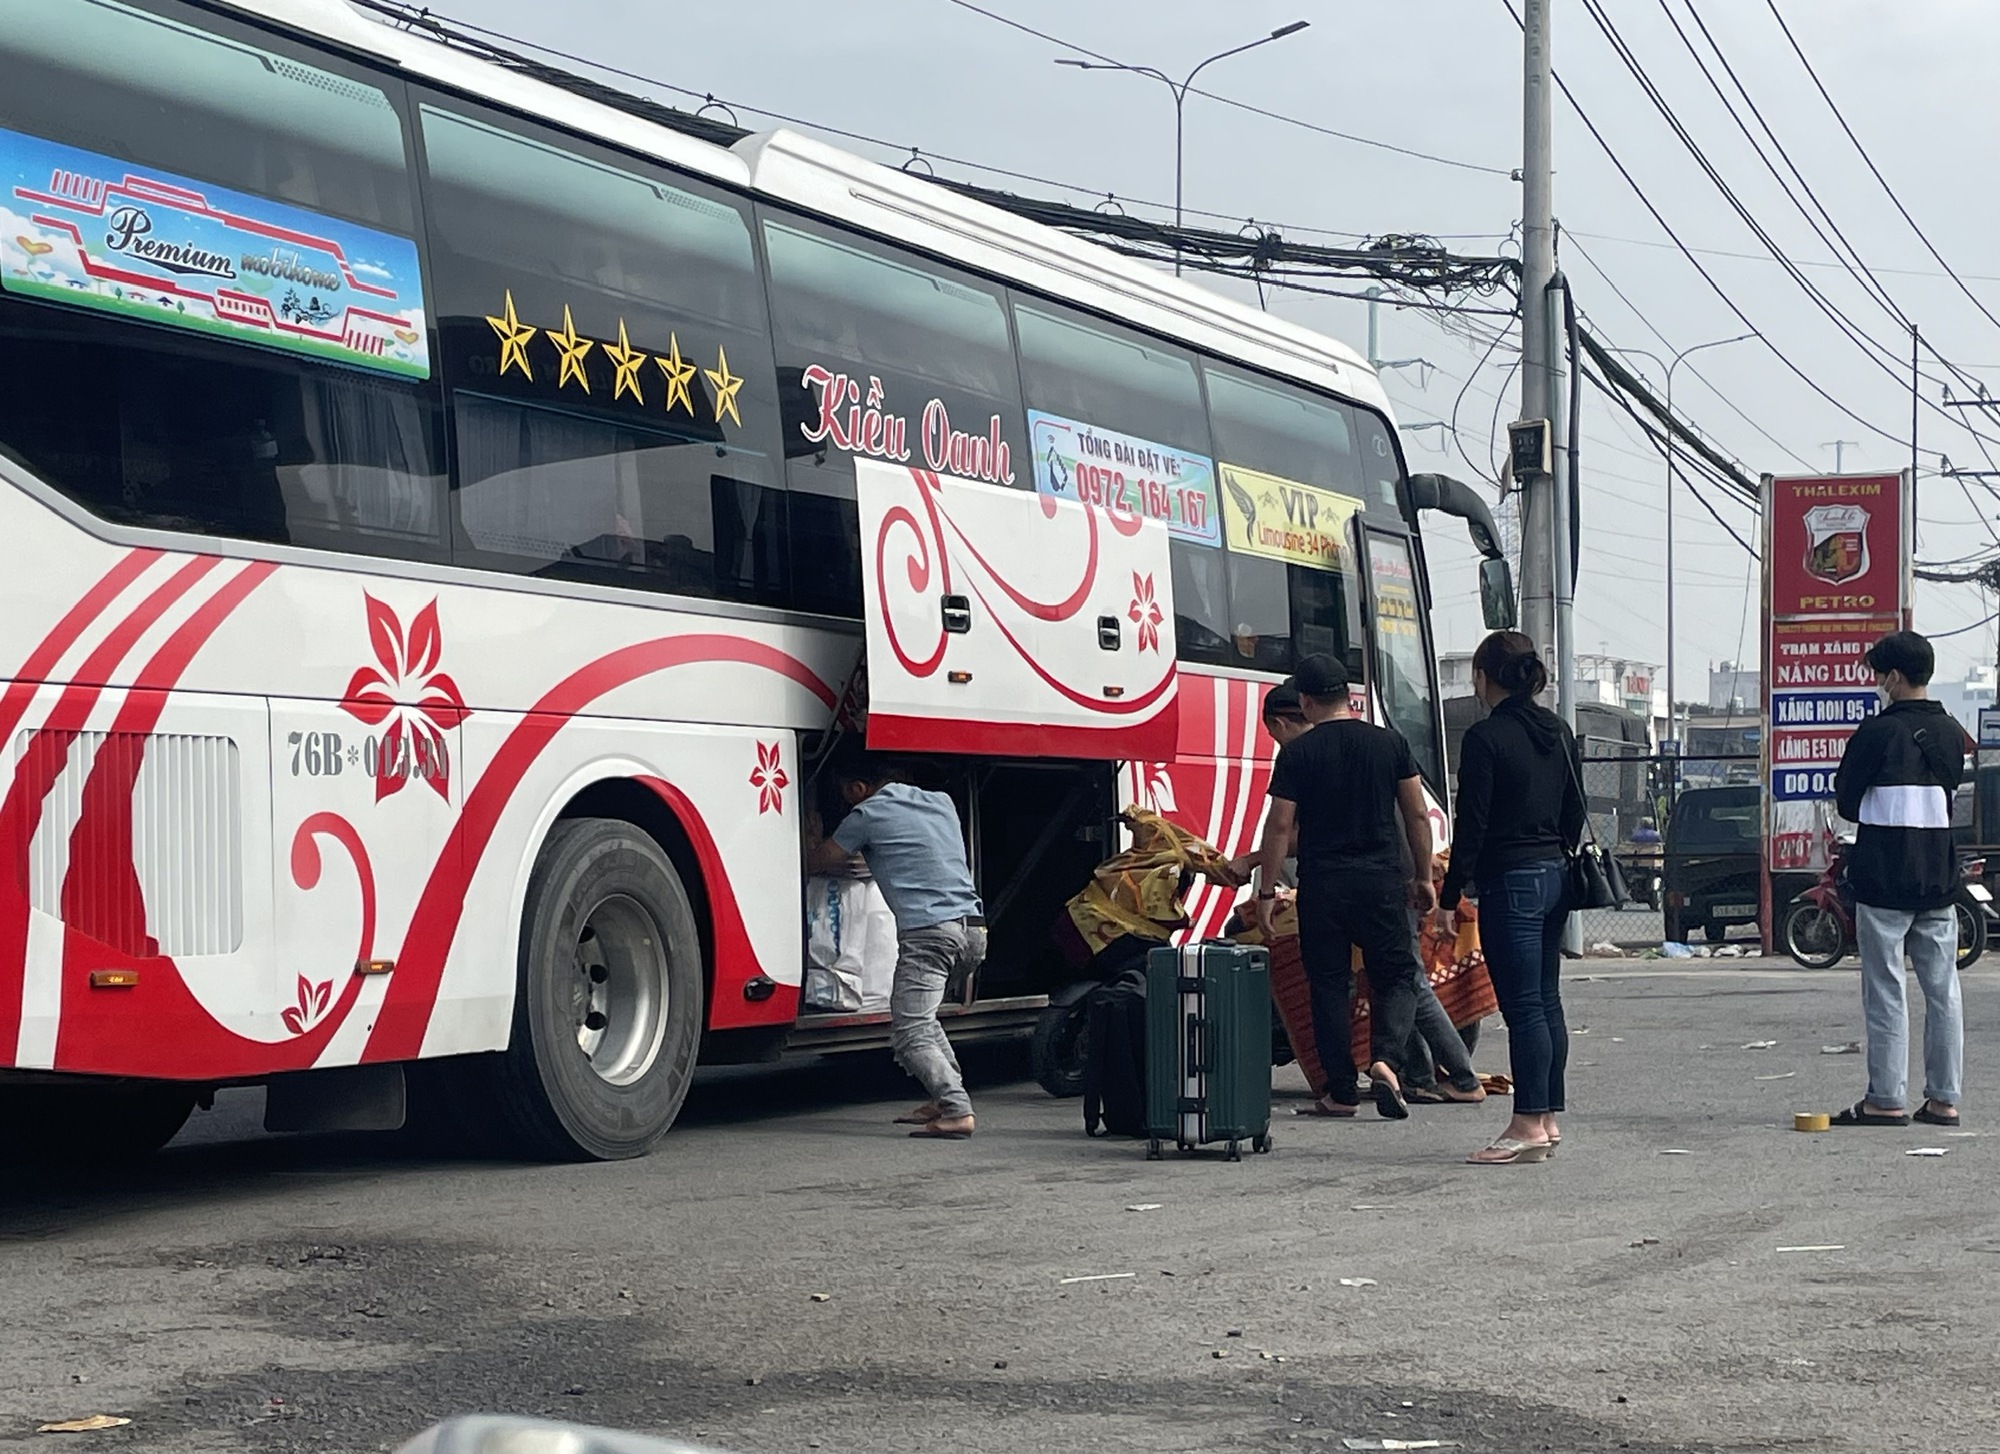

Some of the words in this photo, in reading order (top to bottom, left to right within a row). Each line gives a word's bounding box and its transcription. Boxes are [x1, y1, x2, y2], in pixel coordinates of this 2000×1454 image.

[106, 206, 237, 279] Premium
[801, 364, 910, 462] Kiều
[921, 398, 1015, 485] Oanh
[1077, 427, 1112, 460] TỔNG
[1114, 441, 1136, 467] ĐÀI
[1138, 448, 1160, 475] ĐẶT
[1137, 478, 1172, 521] 164
[1176, 488, 1207, 529] 167
[1791, 484, 1881, 498] THALEXIM
[1279, 486, 1319, 530] VIP
[1257, 520, 1305, 554] Limousine
[1306, 531, 1319, 556] 34
[1799, 595, 1876, 610] PETRO
[1777, 661, 1830, 684] NĂNG
[1778, 697, 1815, 722] XĂNG
[1812, 738, 1827, 758] E5
[1784, 773, 1809, 794] DO
